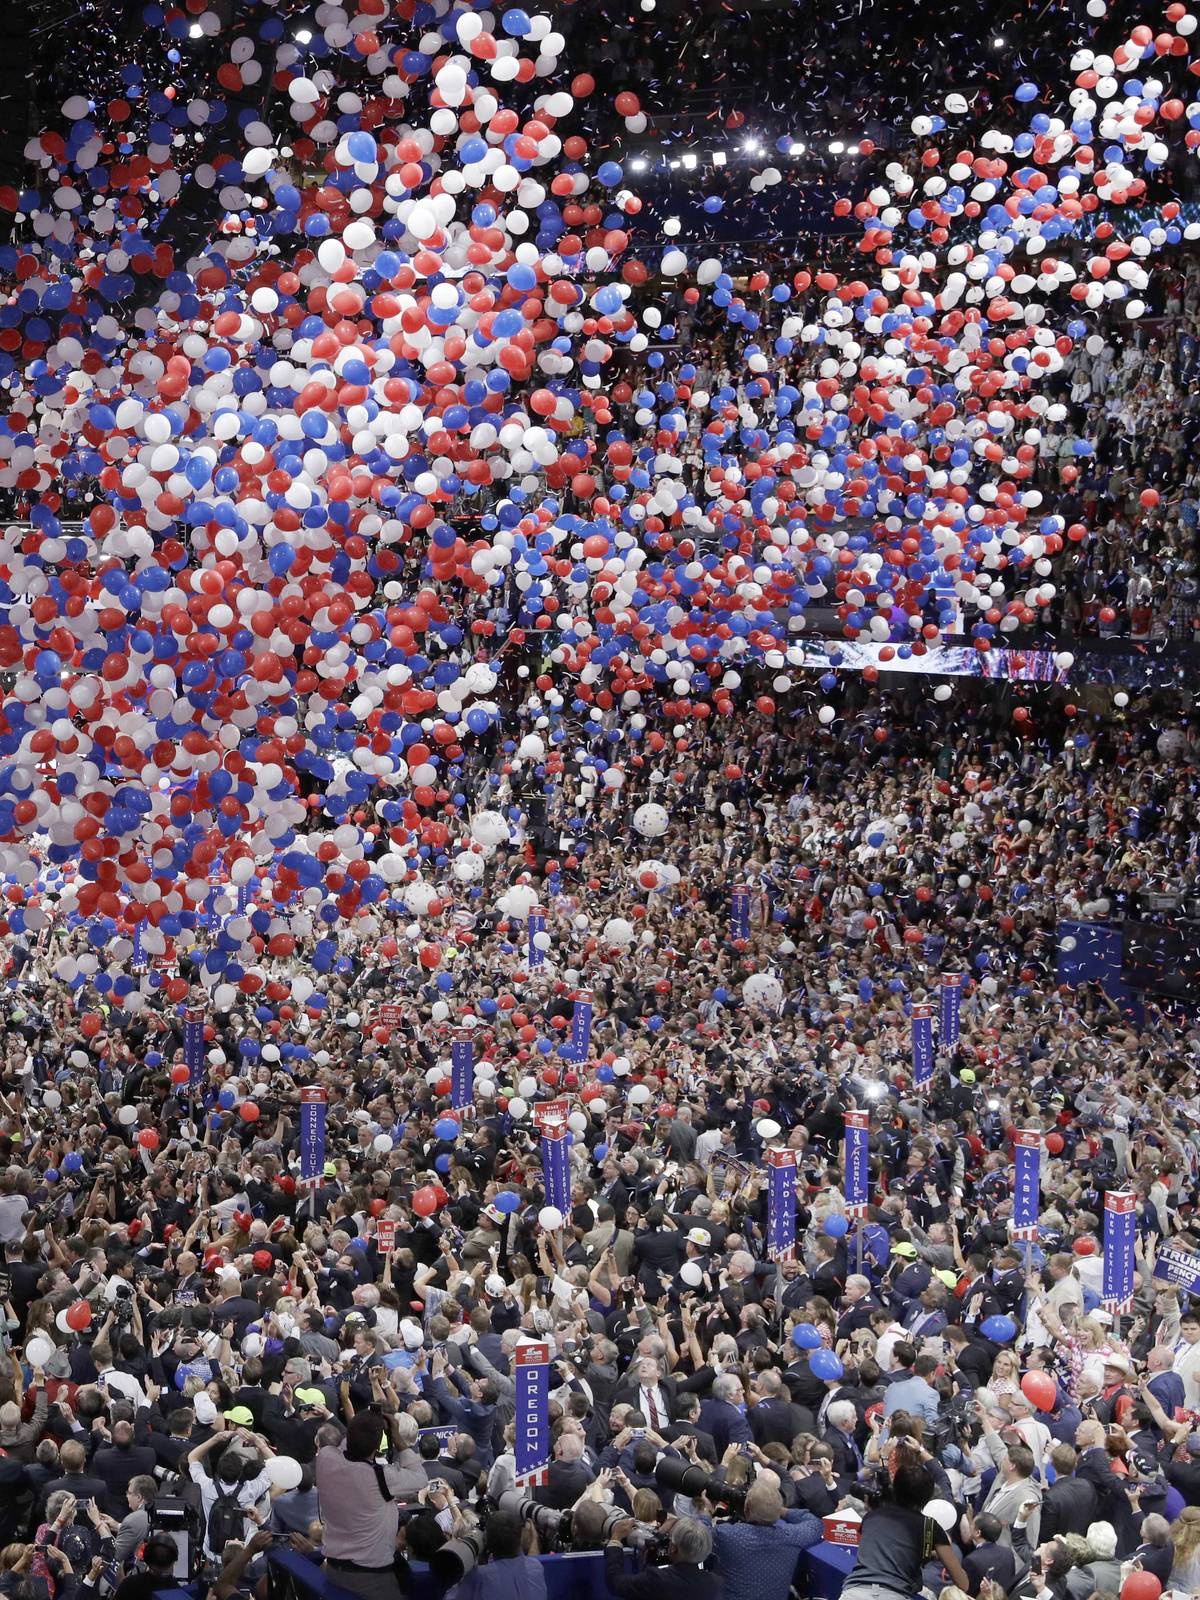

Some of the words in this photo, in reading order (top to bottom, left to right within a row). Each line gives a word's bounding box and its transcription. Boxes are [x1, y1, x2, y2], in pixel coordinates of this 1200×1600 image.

[576, 1005, 586, 1055] FLORIDA
[782, 1170, 790, 1237] INDIANA
[1022, 1150, 1031, 1217] ALASKA
[1168, 1264, 1197, 1282] PENCE
[526, 1370, 538, 1452] OREGON
